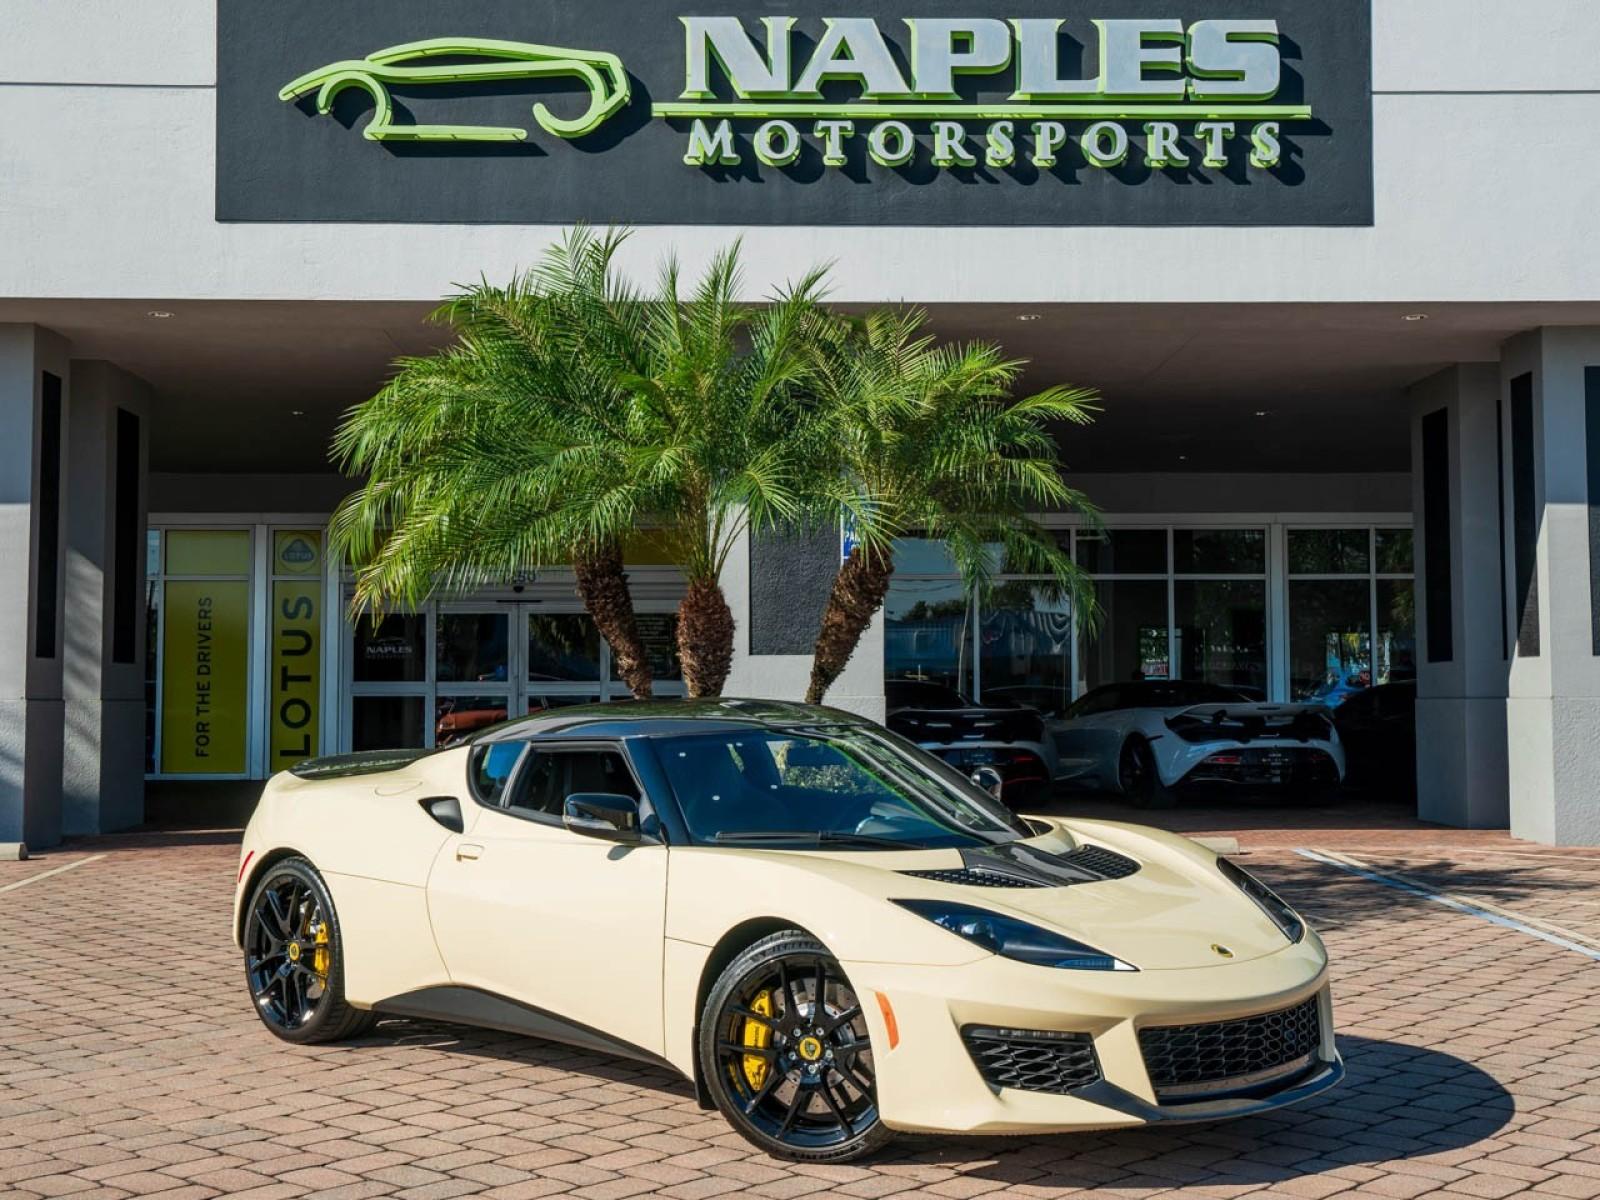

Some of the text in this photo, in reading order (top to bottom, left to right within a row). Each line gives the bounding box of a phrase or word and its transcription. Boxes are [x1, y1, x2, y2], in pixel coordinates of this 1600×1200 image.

[680, 16, 1280, 100] NAPLES
[683, 119, 1281, 168] MOTORSPORTS
[195, 597, 213, 757] FOR THE DRIVERS
[279, 595, 314, 757] LOTUS
[366, 645, 413, 654] NAPLES
